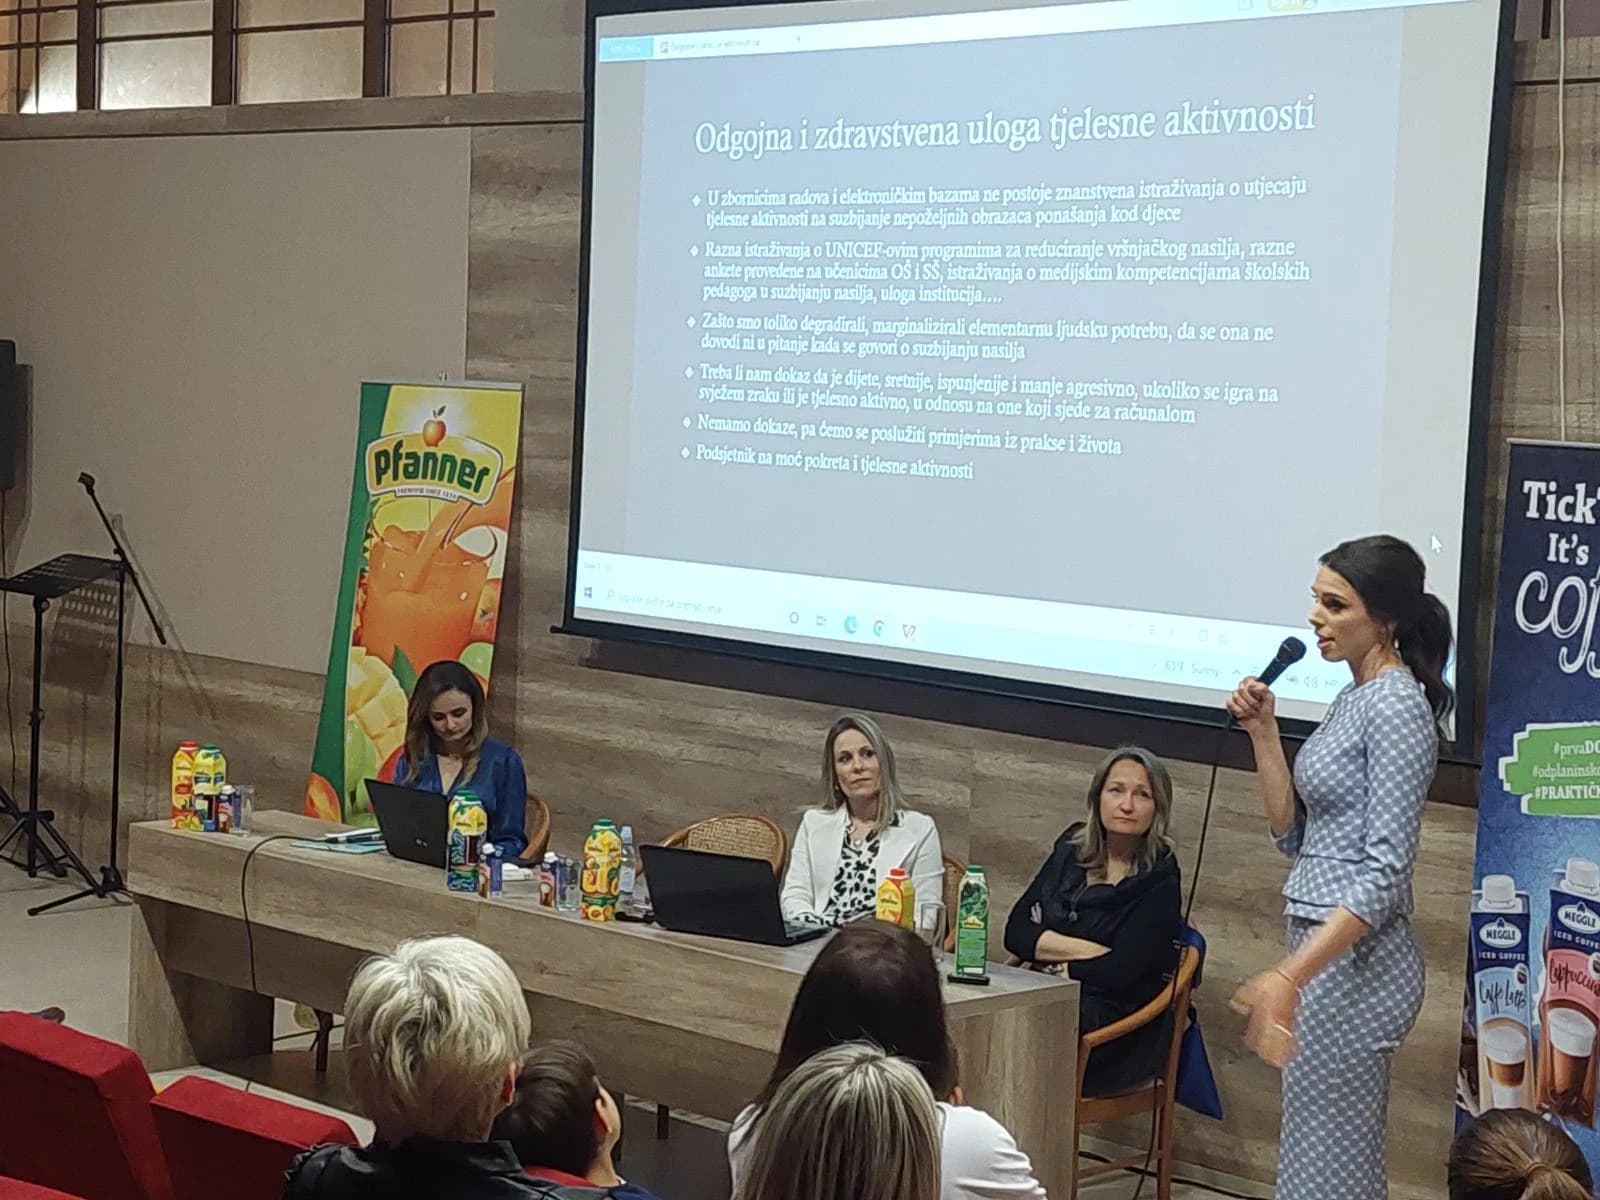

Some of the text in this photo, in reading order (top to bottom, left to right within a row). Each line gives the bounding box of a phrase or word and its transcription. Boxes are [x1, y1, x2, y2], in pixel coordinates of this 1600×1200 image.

[695, 94, 1316, 160] Odgojna i zdravstvena uloga tjelesne aktivnosti
[708, 176, 1307, 206] U zbornicima radova i elektroničkim bazama ne postoje znanstvena istraživanja o utjecaju
[706, 203, 1181, 230] tjelesne aktivnosti na suzbijanje nepoželjnih obrazaca ponašanja kod djece
[705, 237, 1295, 262] Razna istraživanja o UNICEF-ovim programima za reduciranje vršnjačkog nasilja, razne
[704, 259, 1310, 285] ankete provedene na učenicima OŠ i SŠ, istraživanja o medijskim kompetencijama školskih
[703, 282, 757, 302] pedagoga
[760, 286, 769, 299] u
[770, 283, 831, 304] suzbijanju
[834, 284, 878, 305] nasilja,
[880, 287, 916, 305] uloga
[702, 312, 1274, 343] Zašto smo toliko degradirali, marginalizirali elementarnu ljudsku potrebu, da se ona ne
[701, 332, 1025, 363] dovodi ni u pitanje kada se govori o suzbijanju nasilja
[700, 363, 1279, 405] Treba li nam dokaz da je dijete, sretnije, ispunjenije i manje agresivno, ukoliko se igra na
[699, 384, 1196, 424] svježem zraku ili je tjelesno aktivno, u odnosu na one koji sjede za računalom
[697, 414, 1122, 455] Nemamo dokaze, pa ćemo se poslužiti primjerima iz prakse i života
[696, 444, 974, 479] Podsjetnik na moć pokreta i tjelesne aktivnosti
[1546, 533, 1589, 566] It's
[1192, 663, 1219, 678] Sunny
[1486, 928, 1516, 941] MEGGLE
[1564, 911, 1596, 928] MEGGLE
